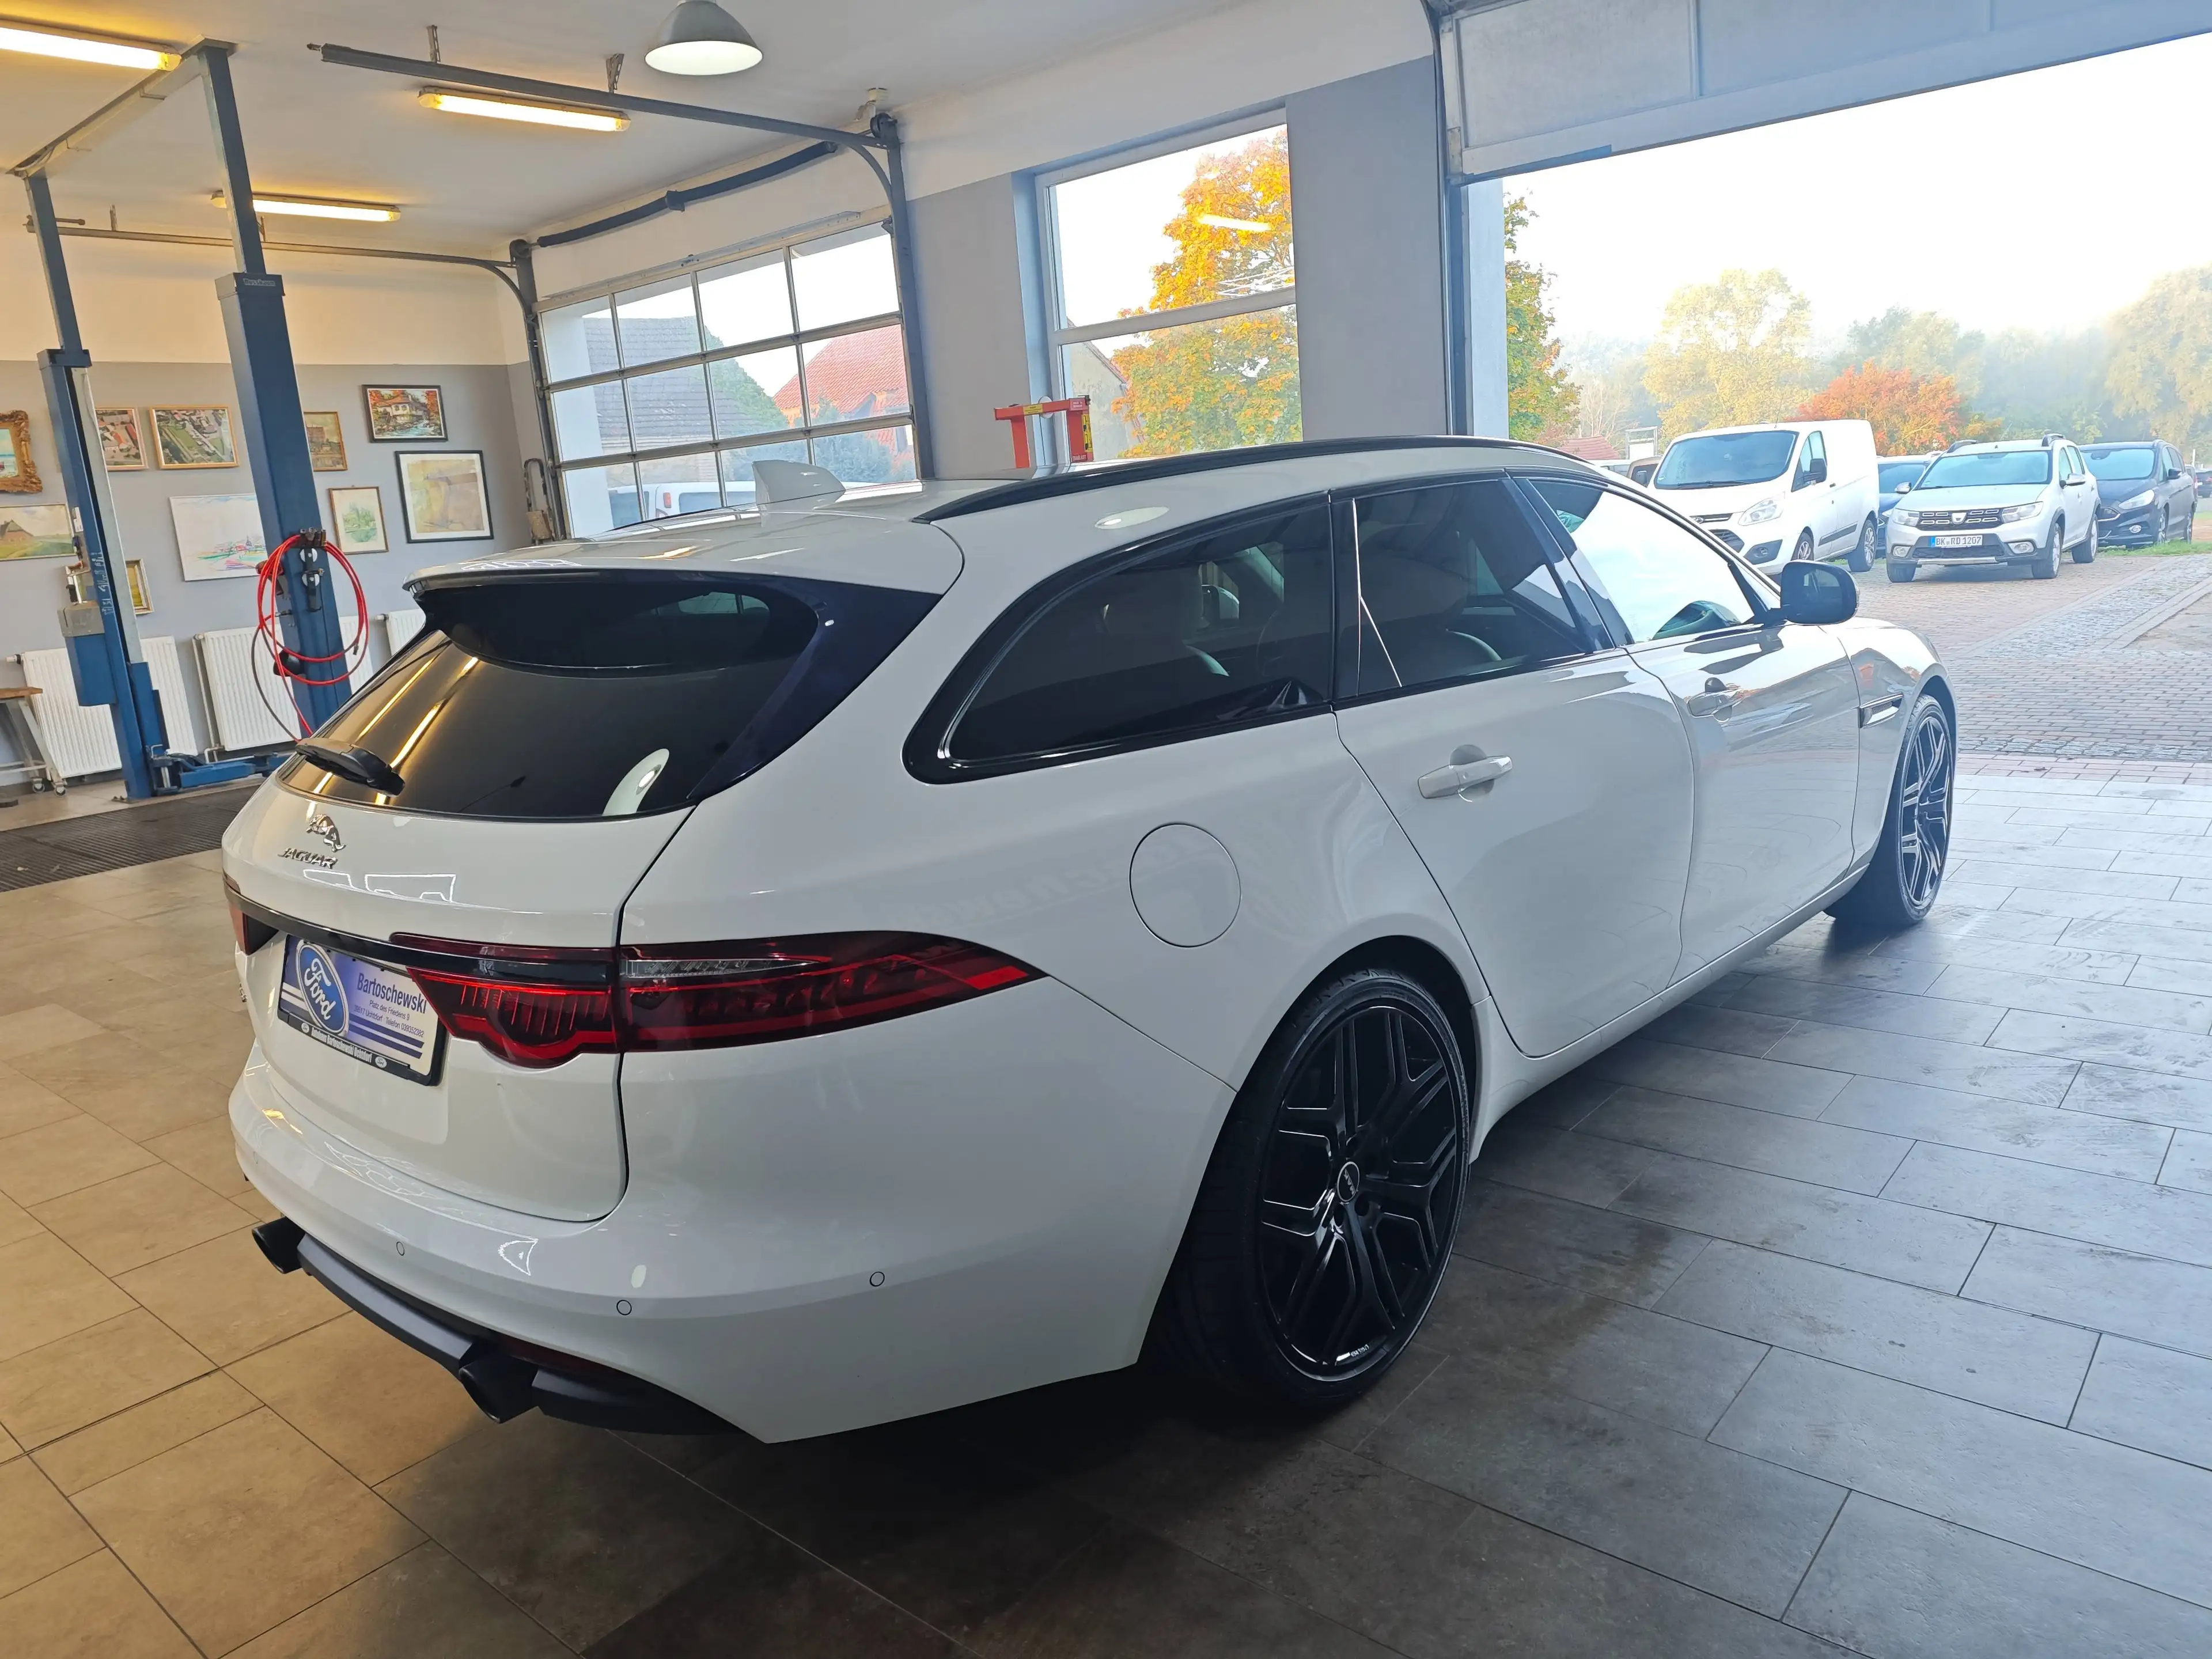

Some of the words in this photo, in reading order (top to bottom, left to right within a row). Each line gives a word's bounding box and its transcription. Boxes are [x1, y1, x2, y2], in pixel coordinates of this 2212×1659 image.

[1963, 536, 1982, 544] 1207
[278, 848, 338, 869] JAGUAR
[304, 958, 336, 1020] Ford
[357, 972, 427, 1014] Bartoschewski
[388, 1006, 406, 1020] Friedens
[385, 1017, 400, 1029] Telefon
